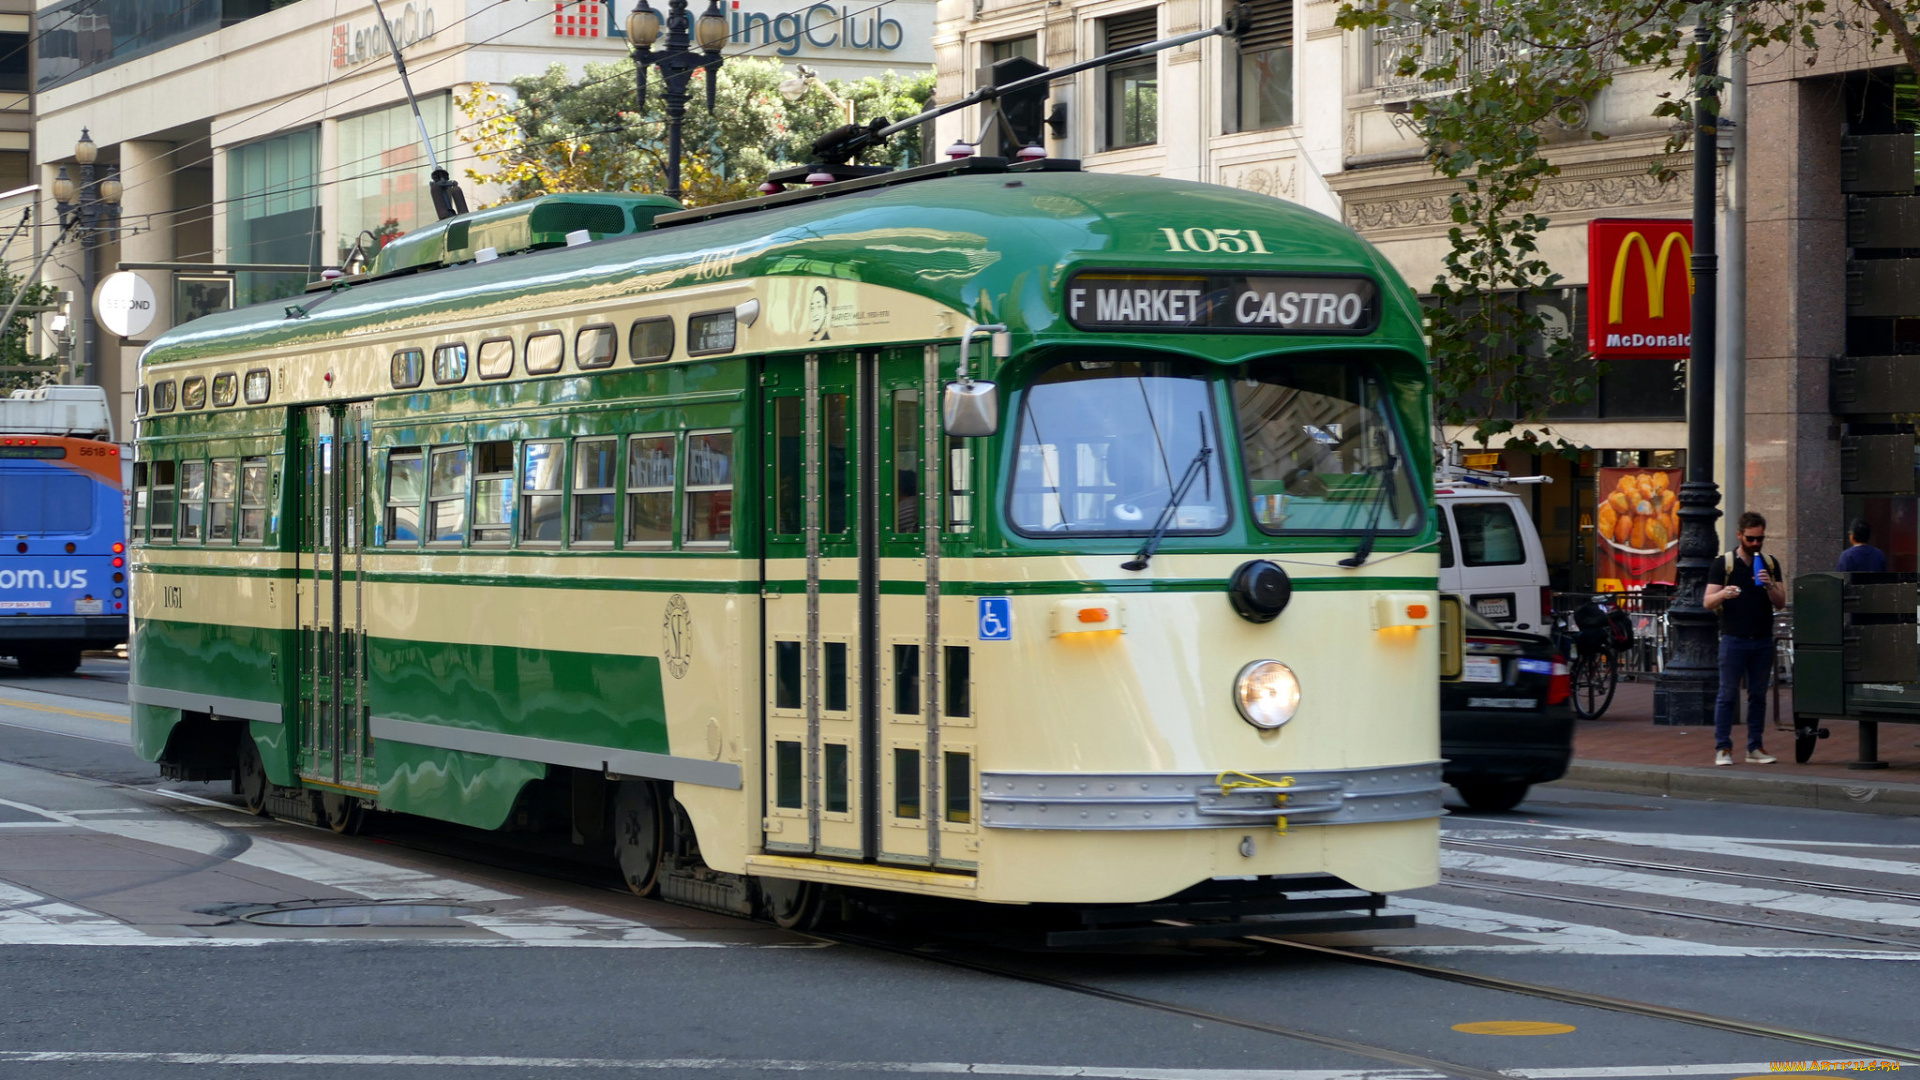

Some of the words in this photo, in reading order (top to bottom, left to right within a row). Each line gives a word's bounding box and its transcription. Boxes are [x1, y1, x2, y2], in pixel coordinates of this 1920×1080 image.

[606, 0, 903, 56] LingClub
[1158, 227, 1274, 255] 1051
[1070, 288, 1087, 321] F
[1096, 289, 1201, 322] MARKET
[1236, 290, 1362, 326] CASTRO
[79, 447, 106, 457] 5618
[0, 569, 88, 589] om.us
[164, 586, 183, 609] 1051
